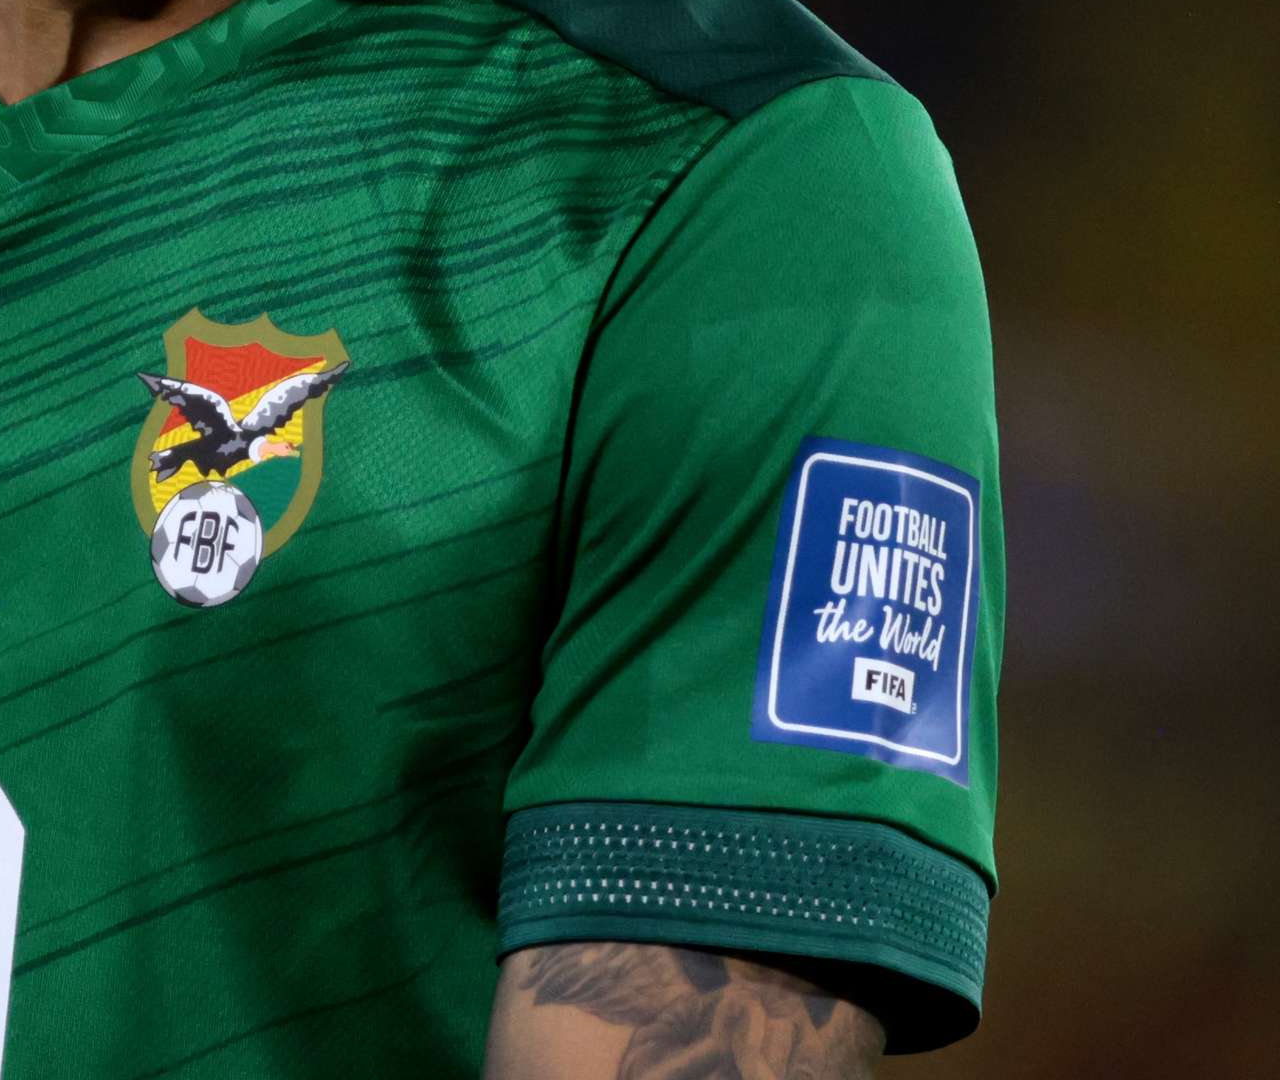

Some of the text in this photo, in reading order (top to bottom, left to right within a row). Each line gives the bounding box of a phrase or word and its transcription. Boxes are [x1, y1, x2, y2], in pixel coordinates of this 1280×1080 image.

[174, 511, 240, 574] FBF
[839, 497, 946, 558] FOOTBALL
[830, 540, 944, 616] UNITES
[813, 598, 945, 672] the World
[865, 669, 905, 701] FIFA
